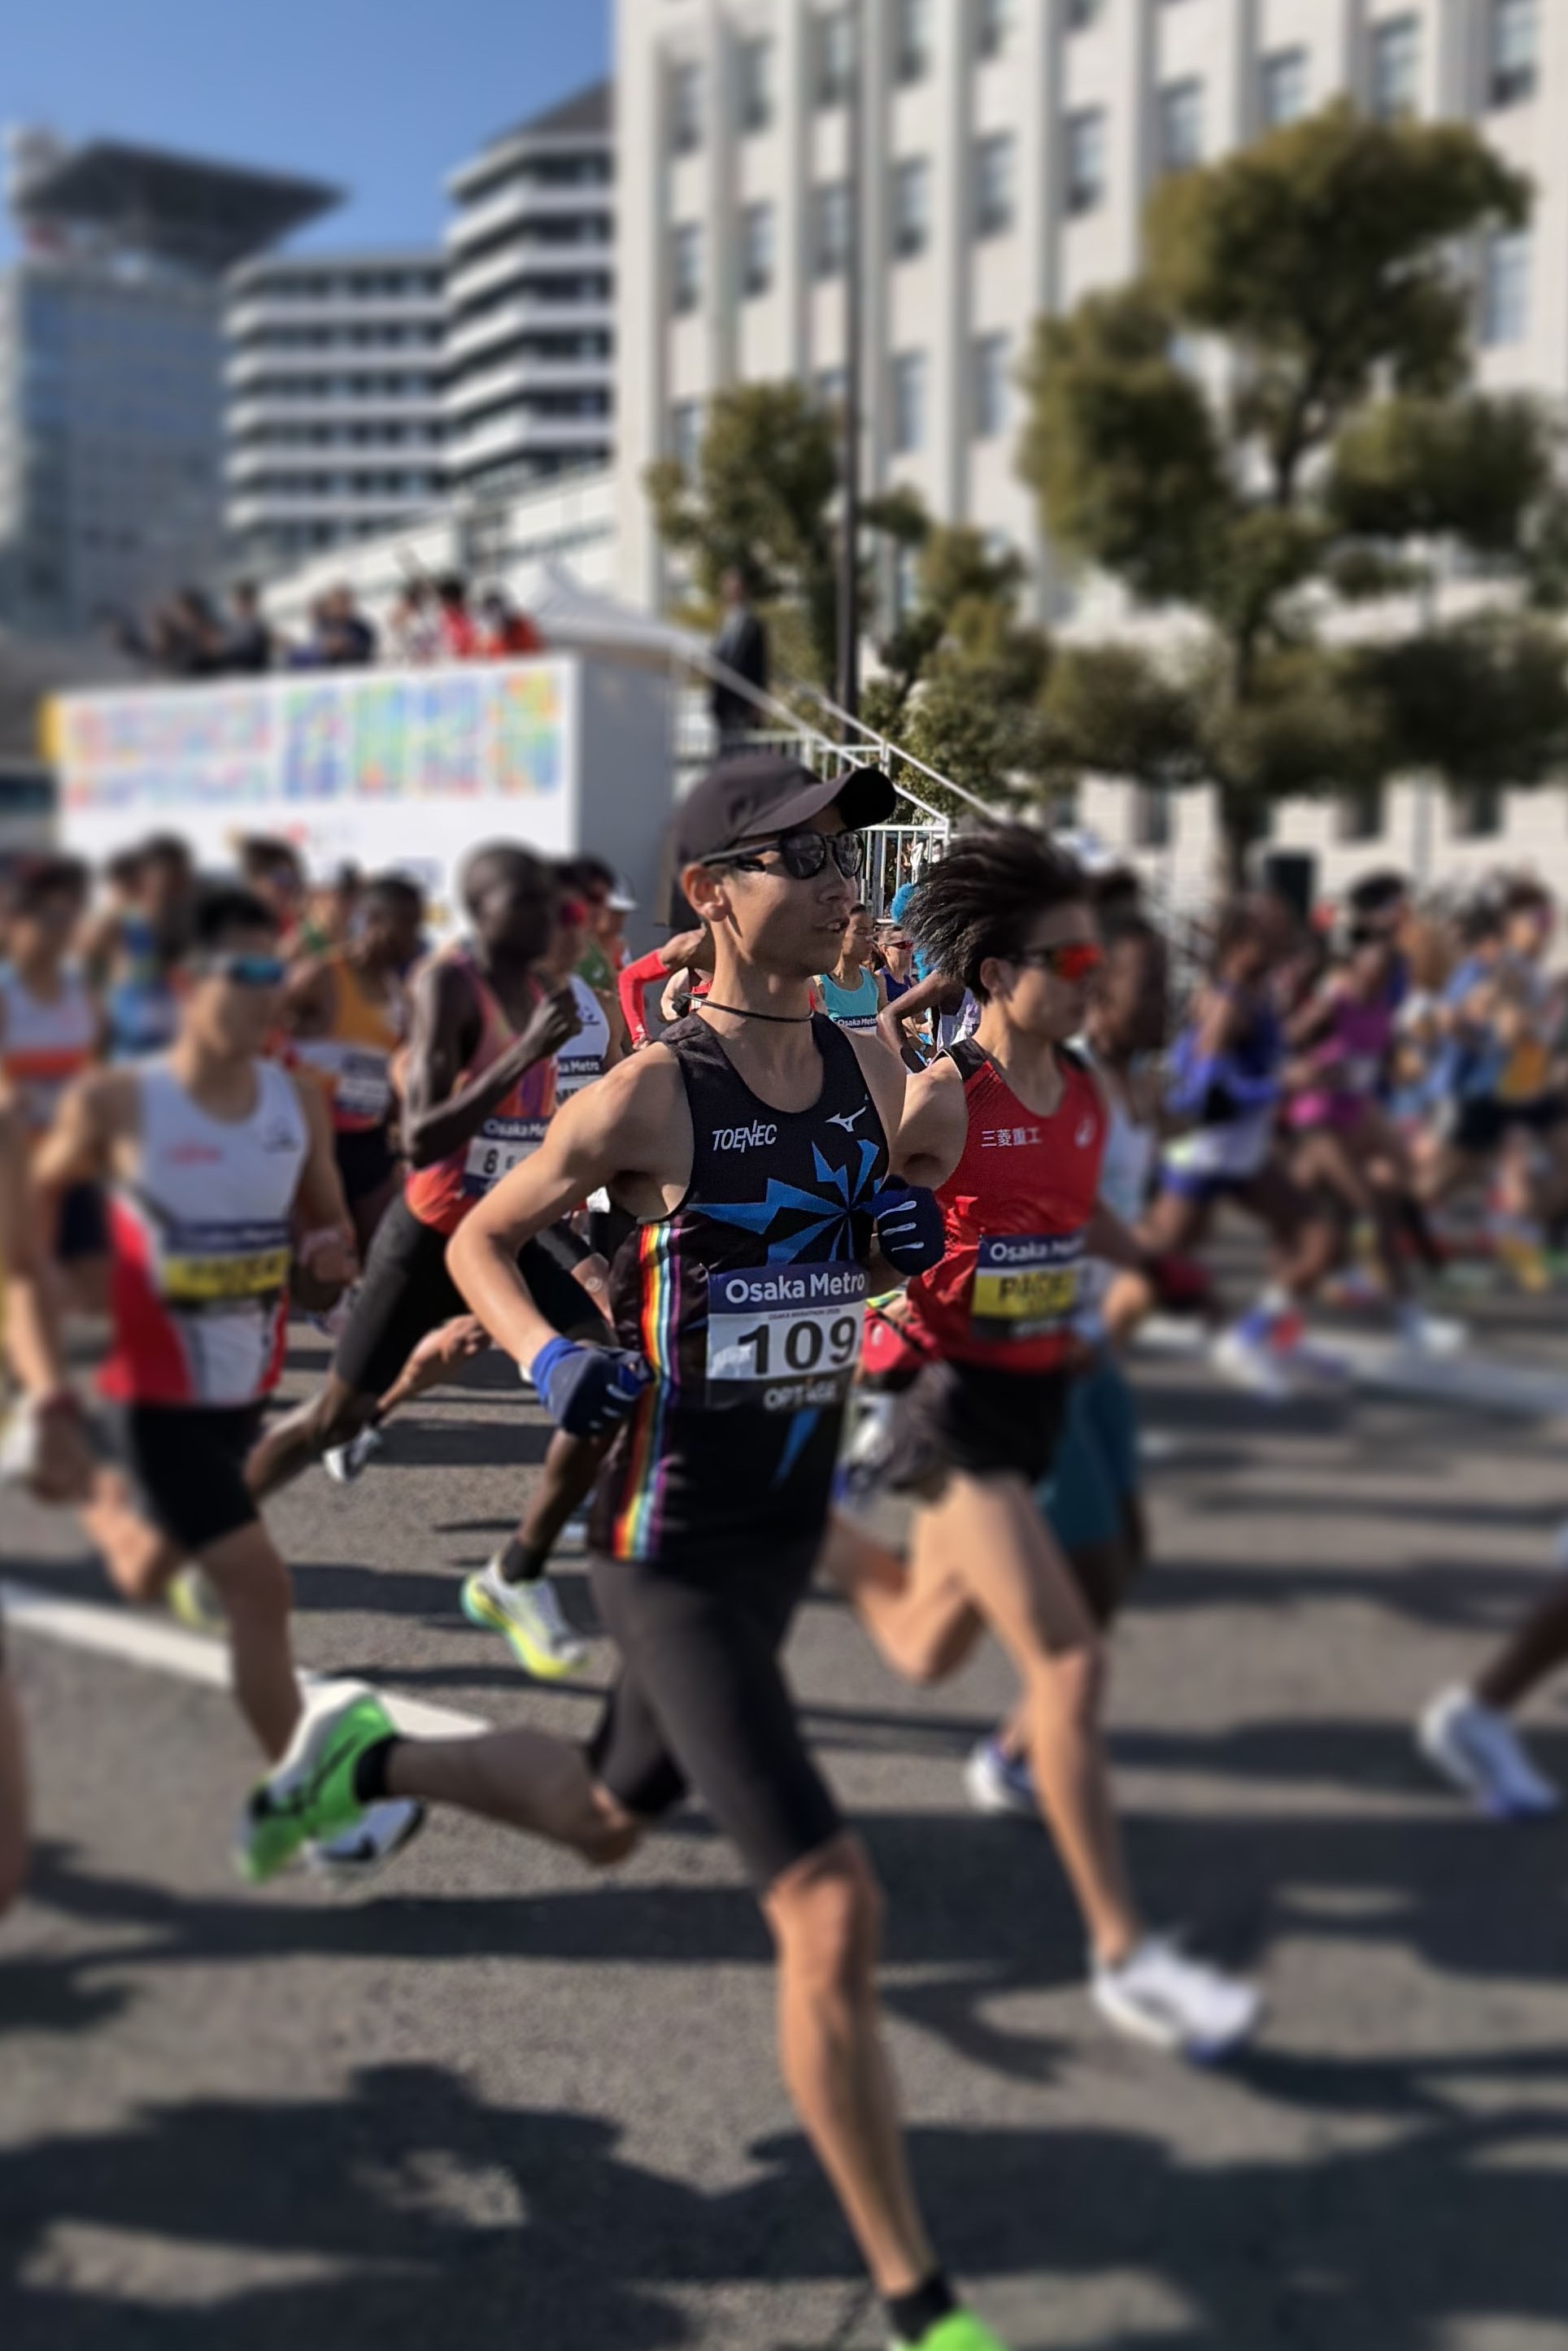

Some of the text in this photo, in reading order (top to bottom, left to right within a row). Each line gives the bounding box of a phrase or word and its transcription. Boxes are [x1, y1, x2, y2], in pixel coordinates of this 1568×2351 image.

[483, 1119, 528, 1136] Osaka
[712, 1120, 777, 1153] TOENEC
[981, 1127, 1043, 1147] 三菱重工
[990, 1241, 1048, 1261] Osaka
[725, 1272, 865, 1304] Osaka Metro
[738, 1316, 857, 1375] 109
